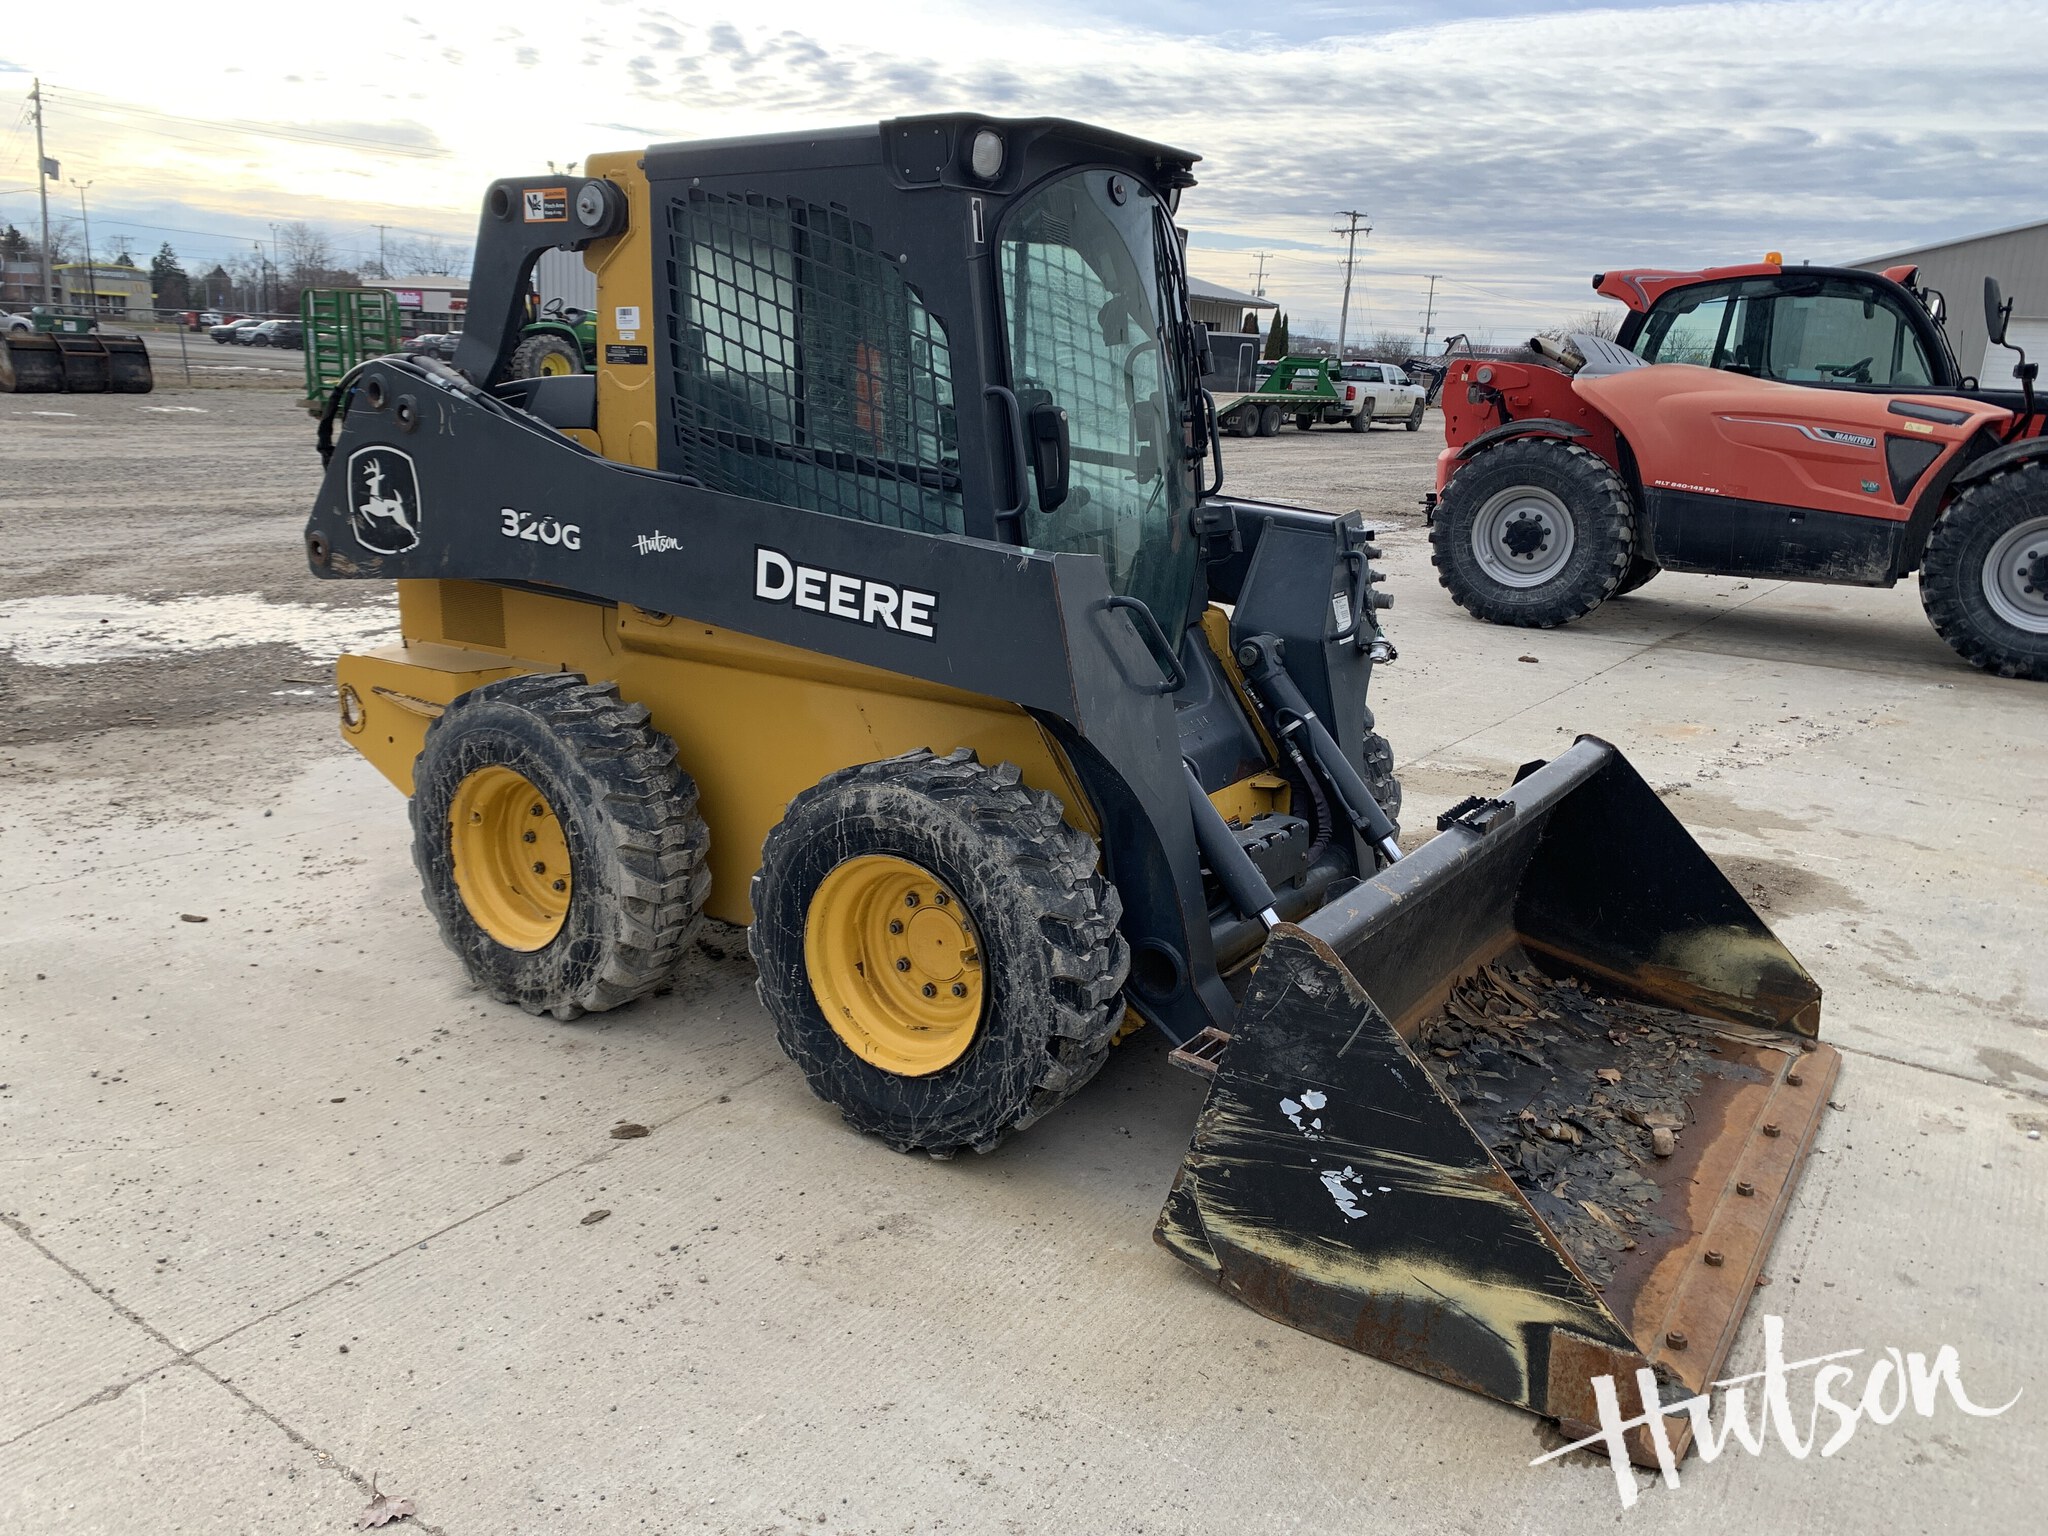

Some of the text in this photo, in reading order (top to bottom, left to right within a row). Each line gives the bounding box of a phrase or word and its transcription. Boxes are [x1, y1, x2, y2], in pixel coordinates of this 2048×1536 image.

[1834, 432, 1873, 445] MANITOU
[1671, 482, 1703, 491] 840-145
[501, 508, 581, 550] 320G
[632, 530, 683, 556] Hutson
[756, 548, 936, 637] DEERE
